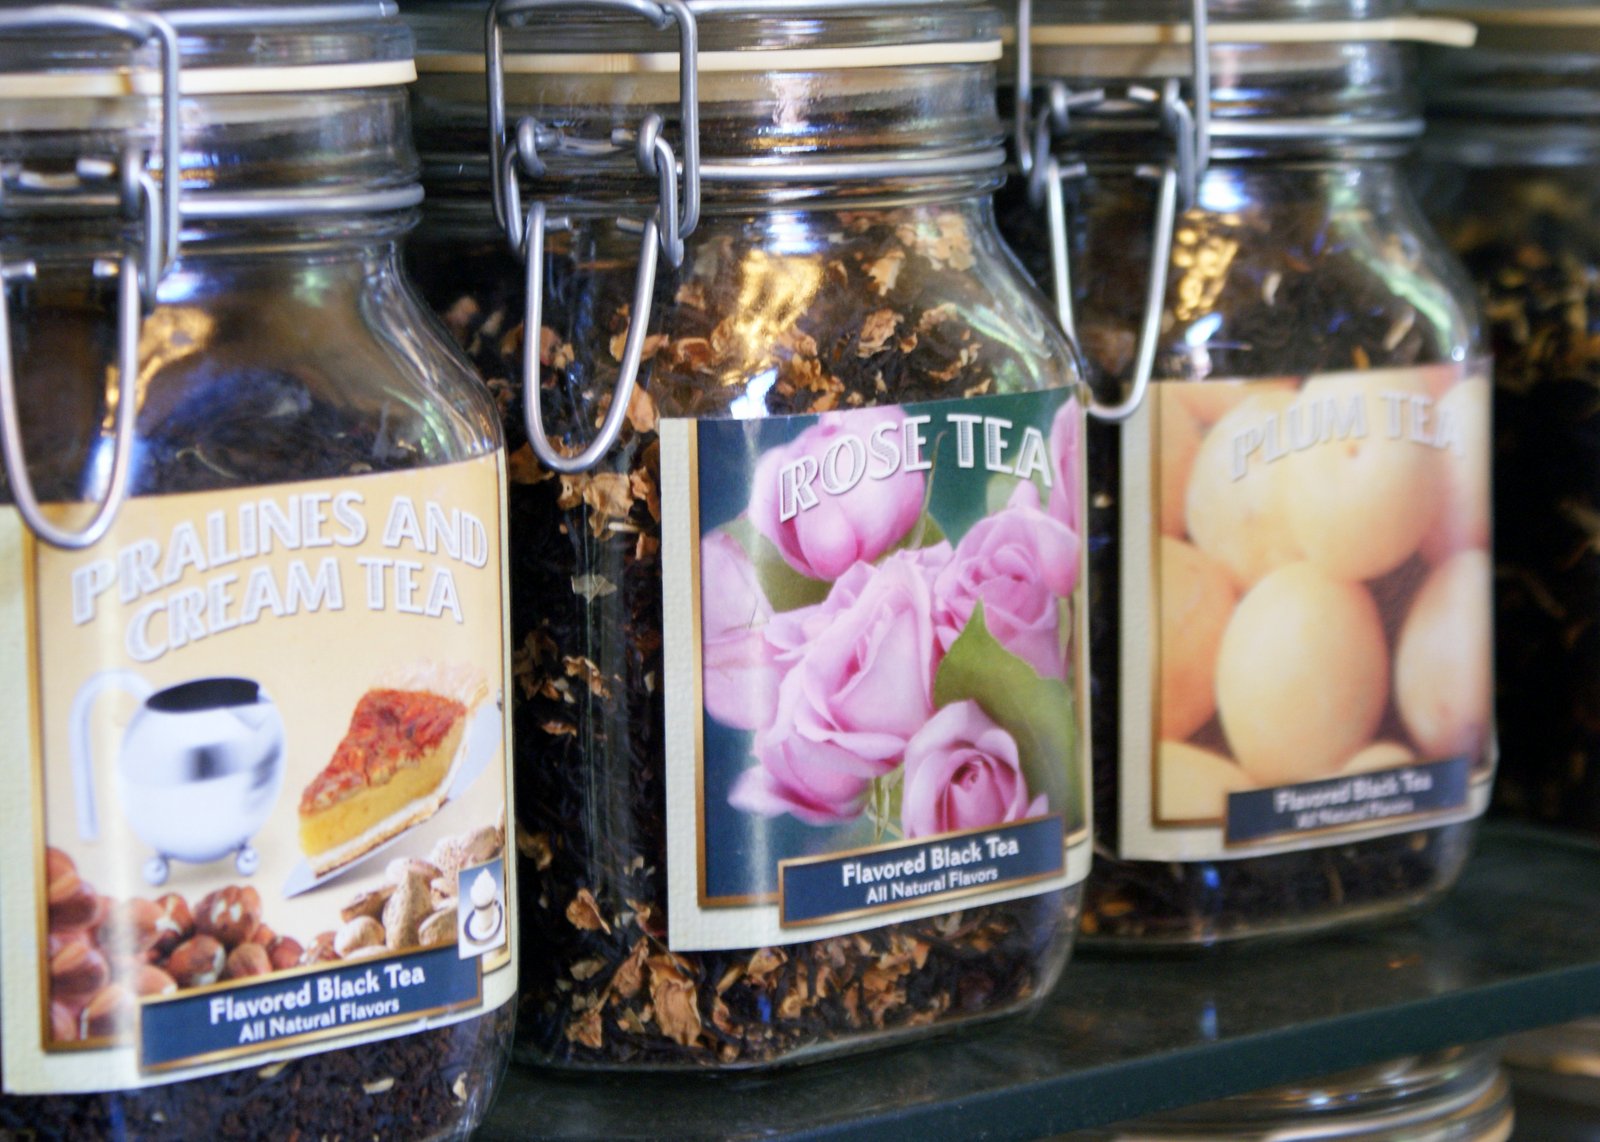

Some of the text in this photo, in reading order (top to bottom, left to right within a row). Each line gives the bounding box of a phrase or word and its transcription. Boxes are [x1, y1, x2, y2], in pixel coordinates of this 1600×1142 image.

[779, 413, 1053, 523] ROSE TEA
[1231, 390, 1465, 482] PLUM TEA
[71, 490, 490, 626] PRALINES AND
[125, 555, 465, 663] CREAM TEA
[842, 835, 1019, 885] Flavored Black Tea
[866, 866, 998, 903] All Natural Flavors
[208, 962, 425, 1023] Flavored Black Tea
[238, 997, 400, 1042] All Natural Flavors
